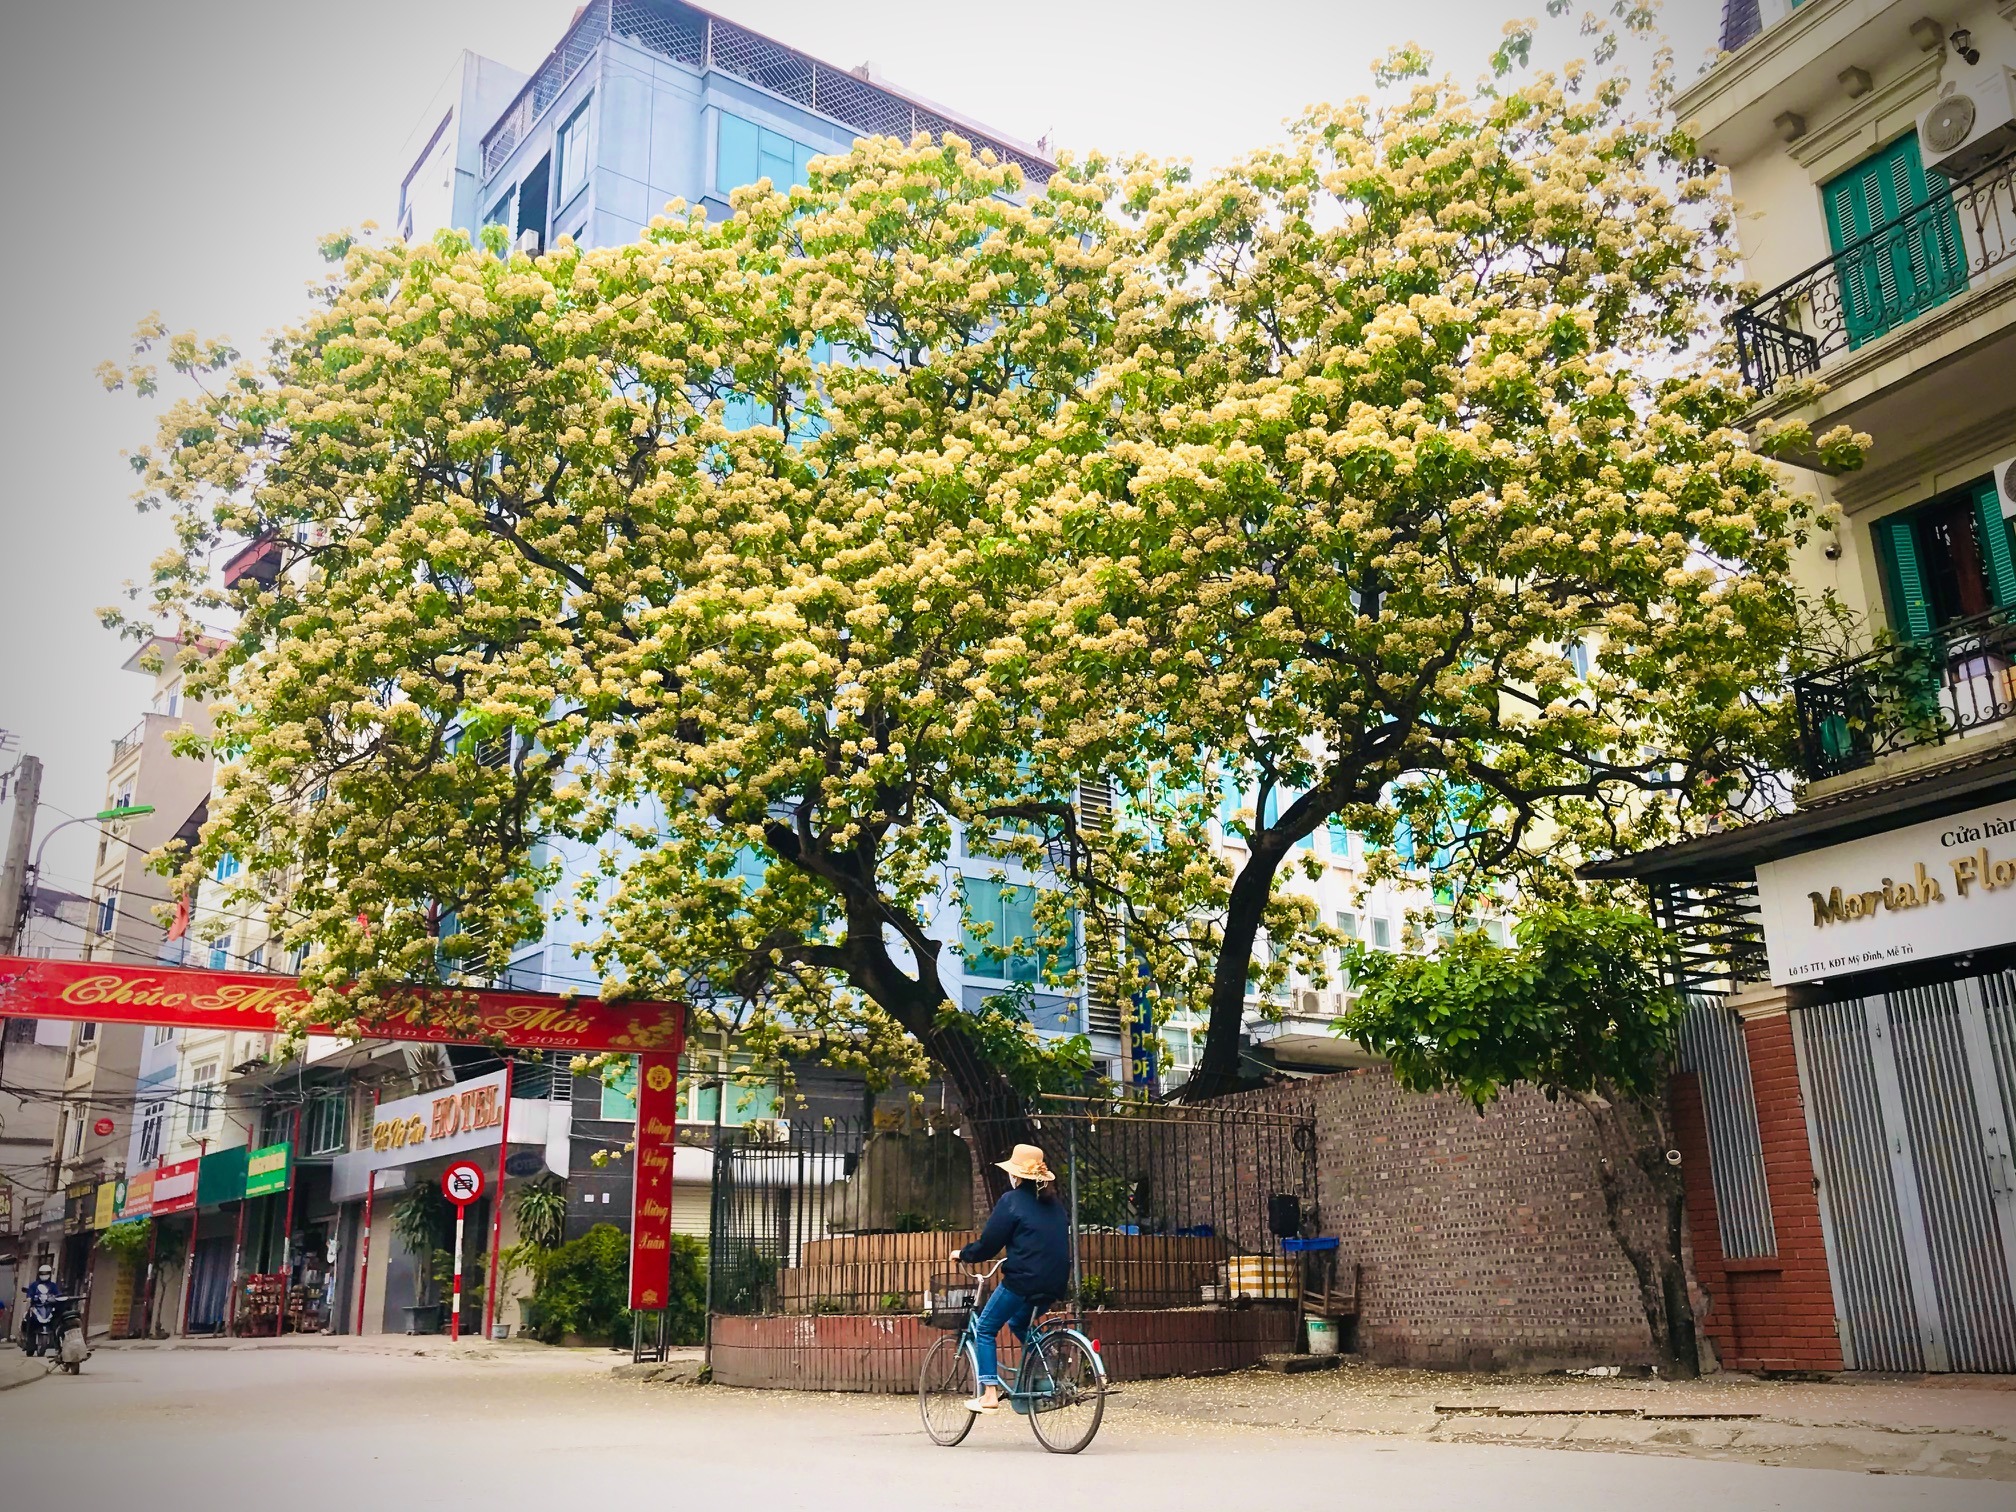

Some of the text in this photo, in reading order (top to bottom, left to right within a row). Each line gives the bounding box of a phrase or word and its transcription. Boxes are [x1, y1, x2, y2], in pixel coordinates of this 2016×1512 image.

[1941, 825, 1981, 847] Cửa
[1808, 847, 2016, 928] Moriah Flo
[1800, 964, 1809, 974] 15
[1829, 957, 1846, 969] KĐT
[1848, 954, 1861, 966] Mỹ
[1886, 945, 1900, 958] Mễ
[1901, 943, 1914, 955] Trì
[62, 975, 188, 1008] Chúc
[484, 1005, 596, 1034] Mới
[527, 1036, 579, 1046] 2020
[430, 1083, 502, 1141] HOTEL
[642, 1117, 672, 1142] Mừng
[639, 1197, 669, 1224] Mừng
